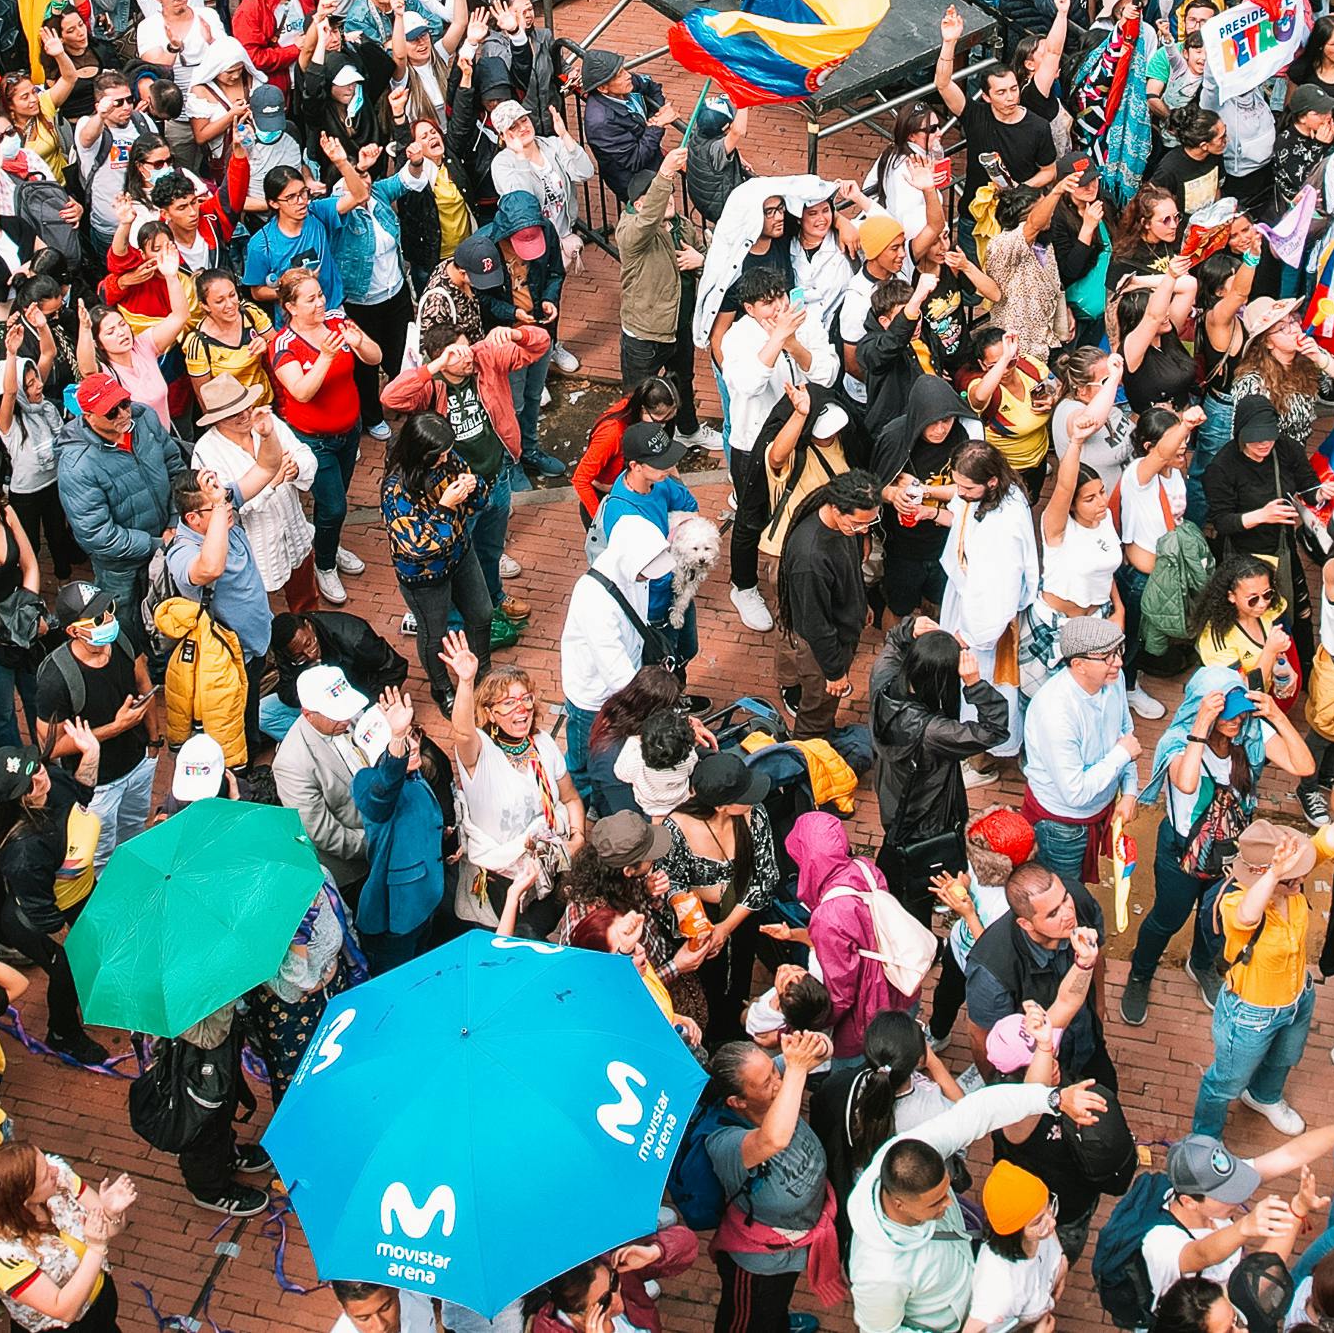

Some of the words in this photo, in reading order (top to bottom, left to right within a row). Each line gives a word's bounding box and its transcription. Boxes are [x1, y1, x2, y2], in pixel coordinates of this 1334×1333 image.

[1223, 9, 1297, 72] PETRO
[637, 1090, 670, 1162] movistar
[654, 1113, 677, 1160] arena
[376, 1242, 451, 1270] movistar
[388, 1262, 436, 1284] arena
